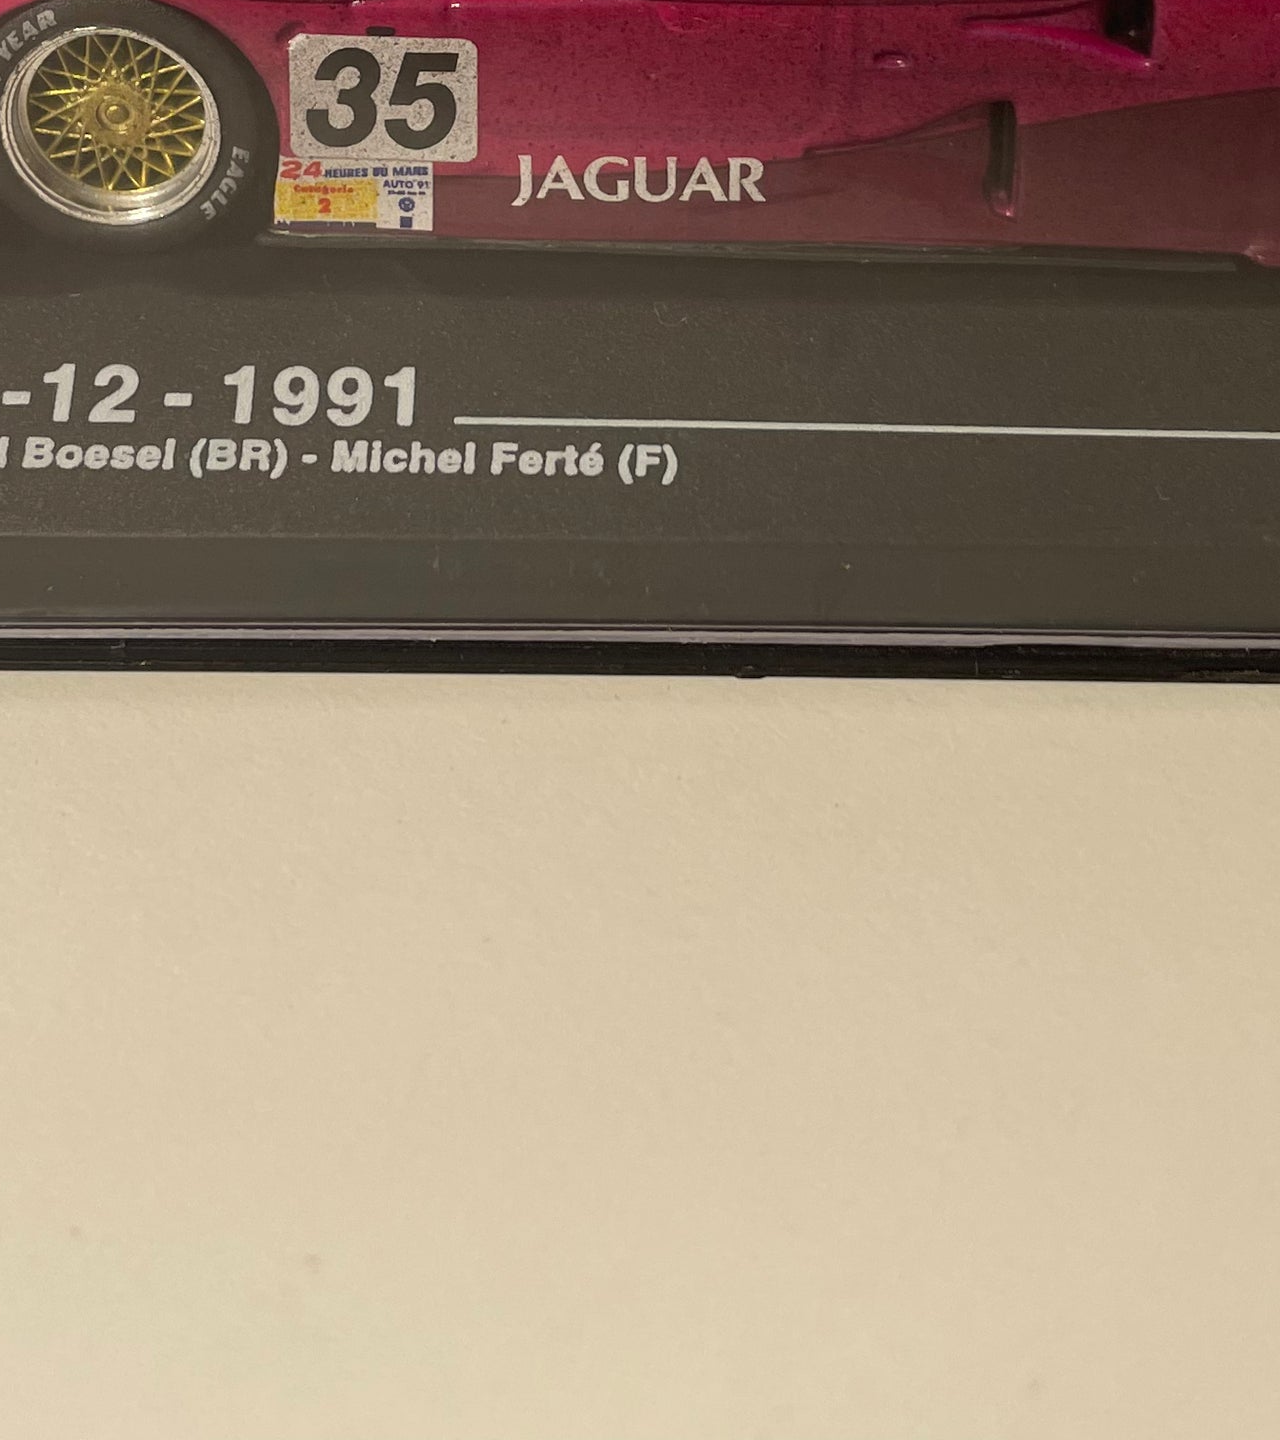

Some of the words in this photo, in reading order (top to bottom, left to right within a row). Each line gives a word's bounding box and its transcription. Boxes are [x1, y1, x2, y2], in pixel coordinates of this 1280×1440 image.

[305, 46, 459, 150] 35
[199, 145, 251, 221] EAGLE
[279, 160, 323, 180] 24
[324, 166, 369, 179] HEURES
[510, 154, 767, 207] JAGUAR
[317, 197, 332, 215] 2
[223, 364, 418, 427] 1991
[21, 436, 177, 471] Boesel
[189, 437, 289, 480] (BR)
[330, 438, 477, 475] Michel
[488, 440, 606, 477] Ferté
[617, 442, 679, 485] (F)
